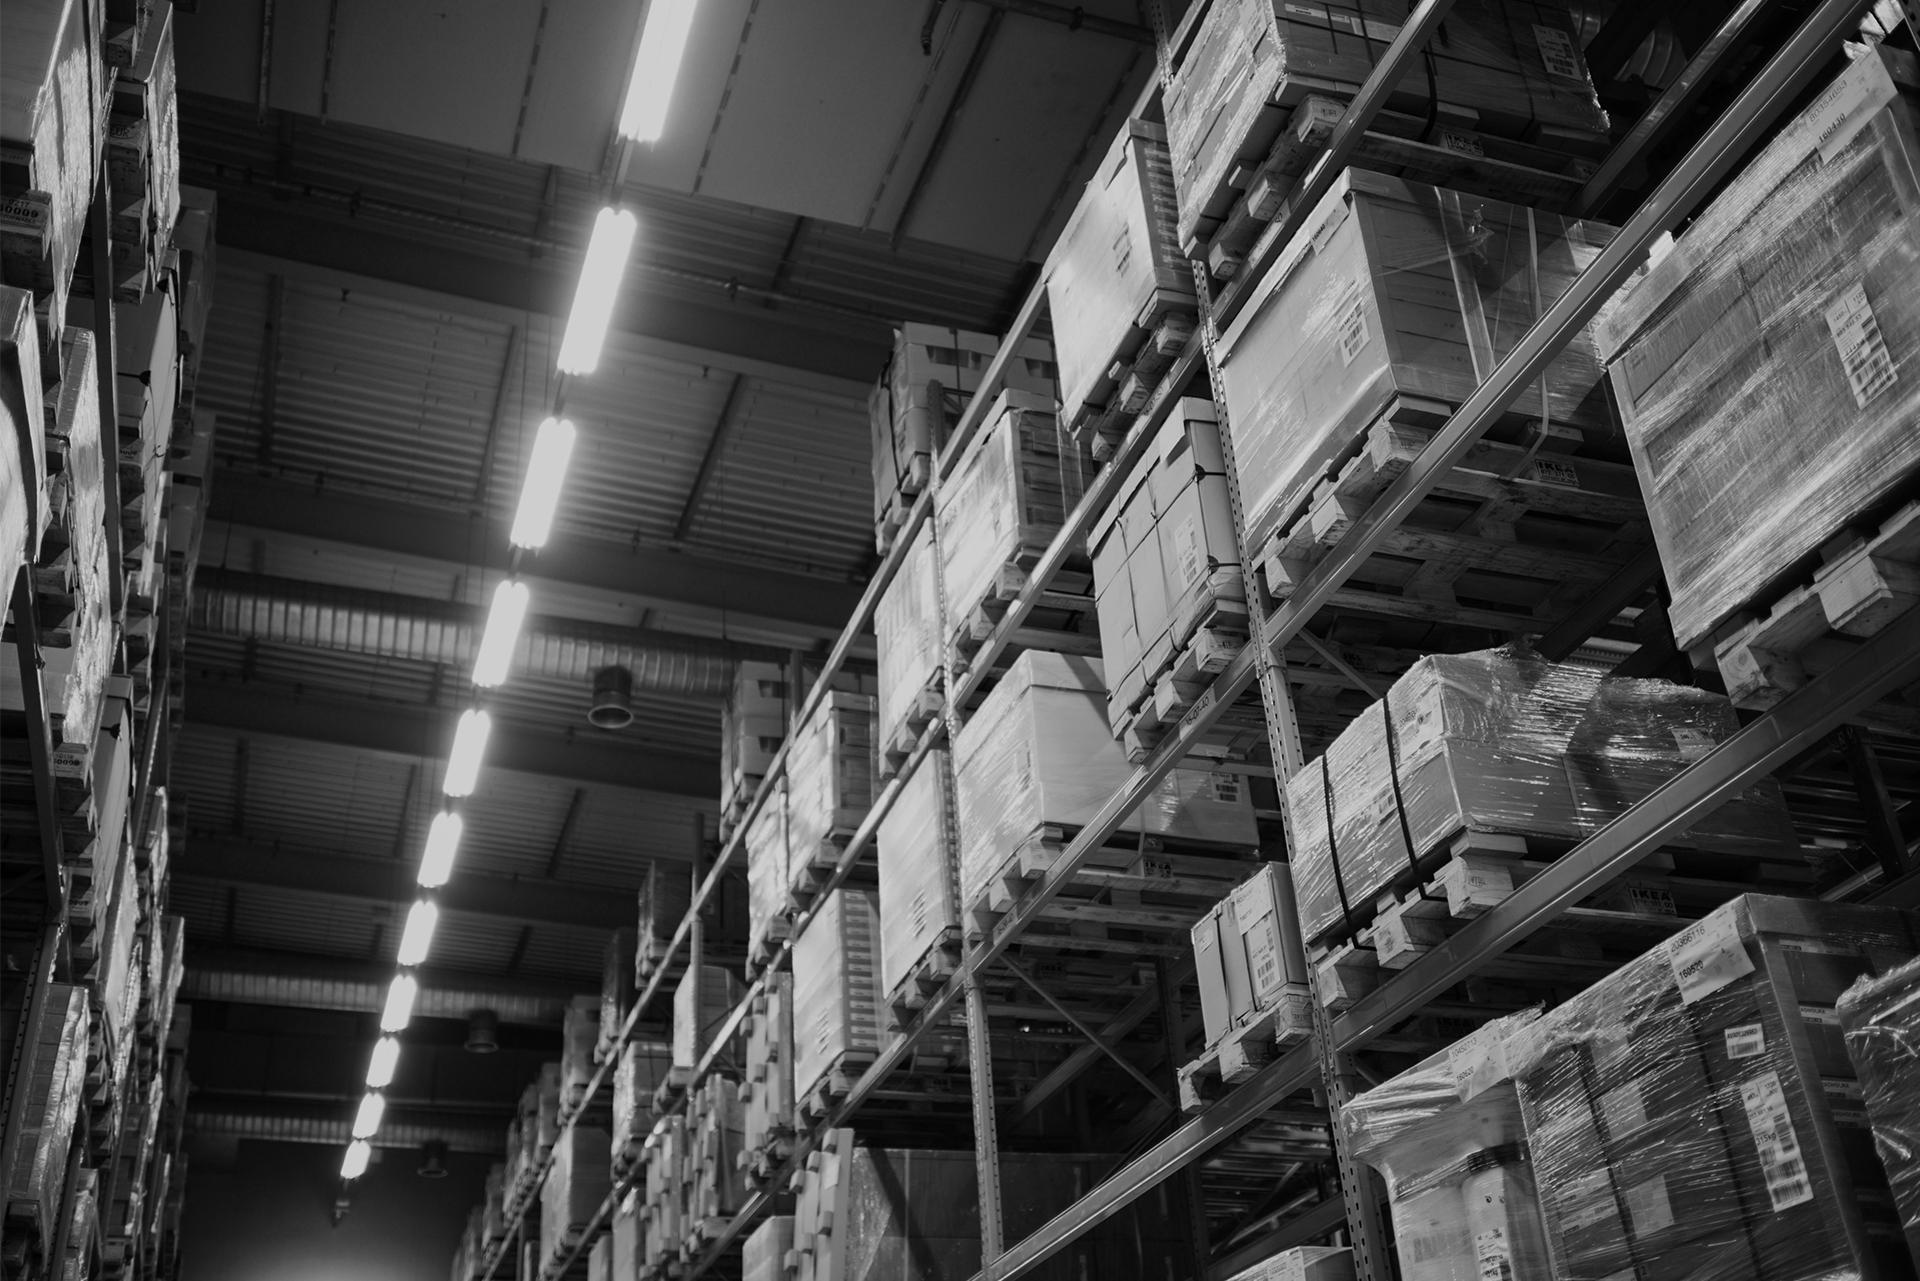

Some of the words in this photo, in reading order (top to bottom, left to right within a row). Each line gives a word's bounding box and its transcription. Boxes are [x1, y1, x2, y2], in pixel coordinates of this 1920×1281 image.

[1809, 80, 1848, 122] 80354653
[1819, 113, 1846, 143] 160430
[8, 199, 29, 208] 0217
[1538, 461, 1574, 473] IKEA
[1632, 889, 1672, 901] IKEA
[1671, 925, 1706, 952] 20366116
[1678, 960, 1704, 980] 160520
[1457, 1066, 1474, 1082] 160620
[1641, 1265, 1647, 1276] 2
